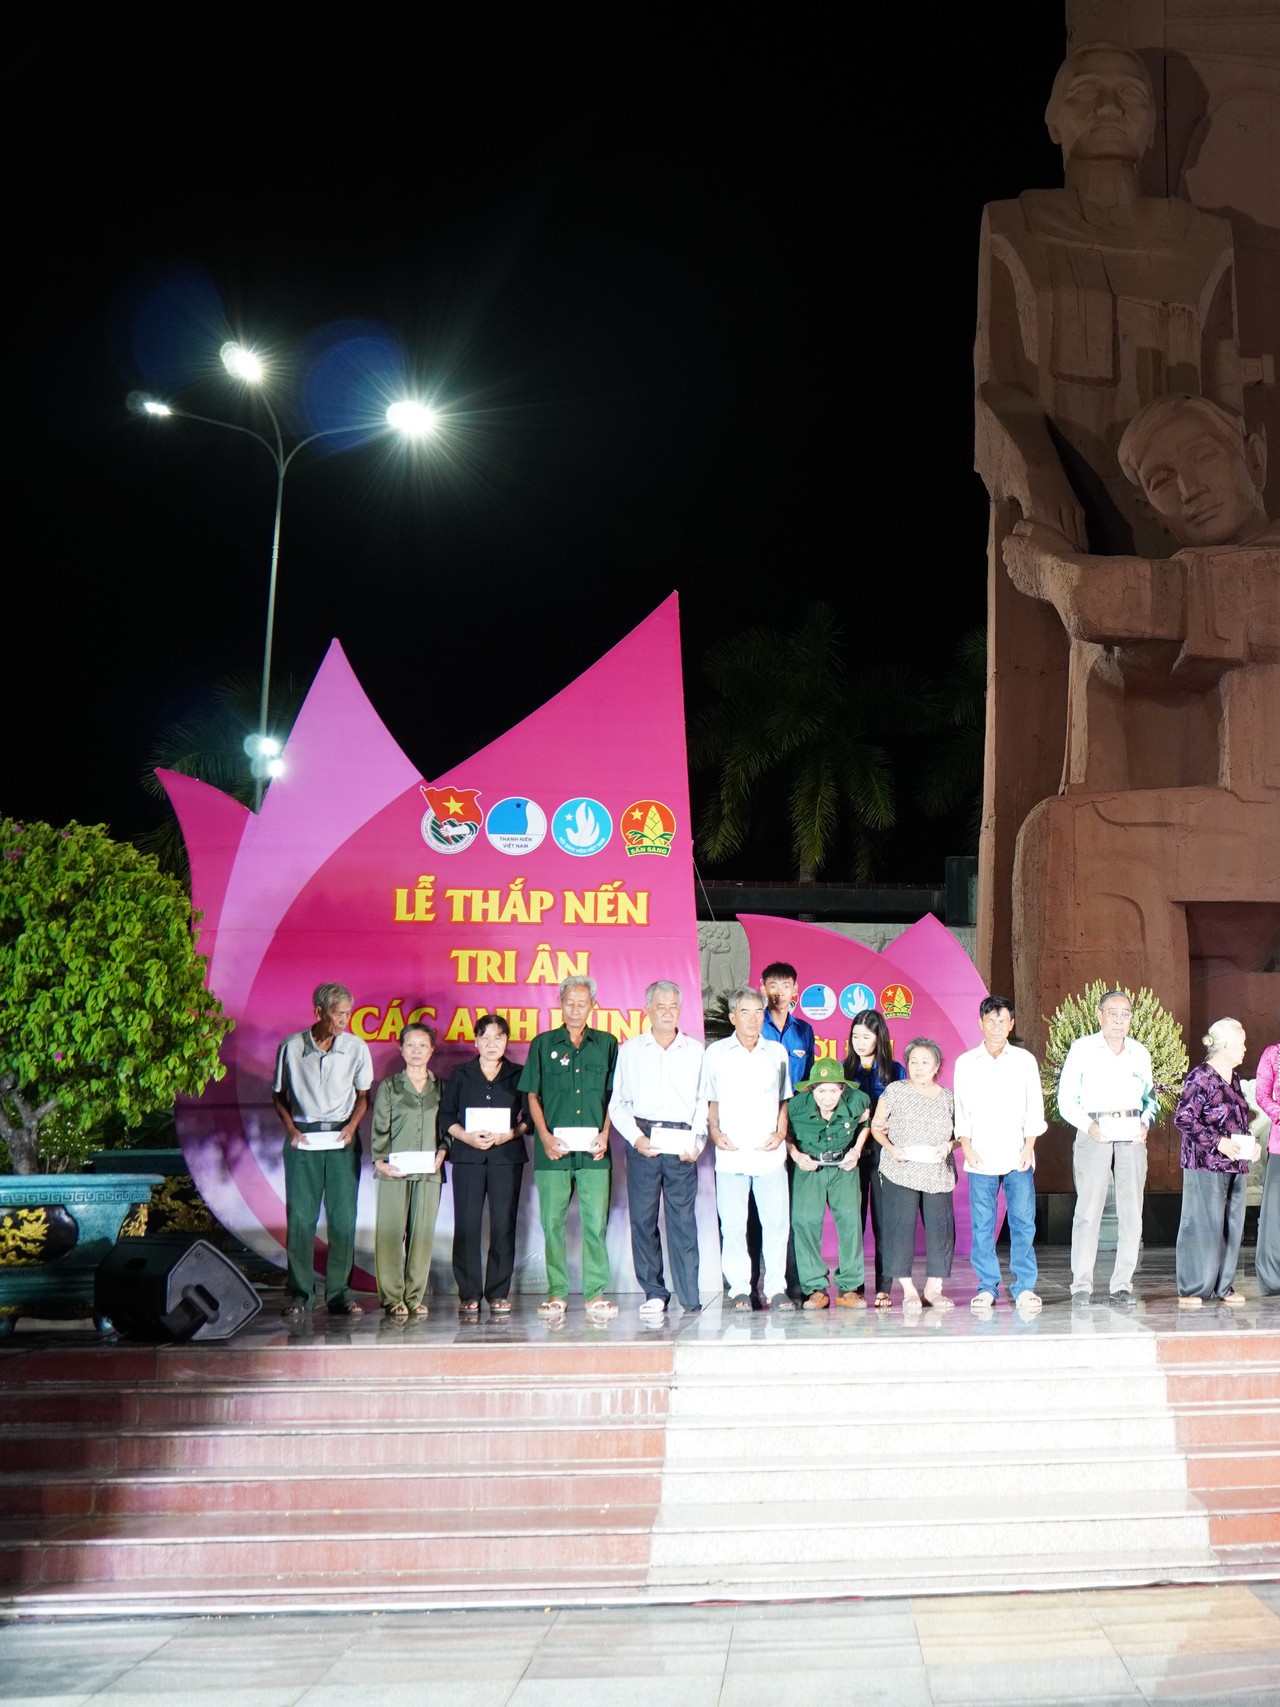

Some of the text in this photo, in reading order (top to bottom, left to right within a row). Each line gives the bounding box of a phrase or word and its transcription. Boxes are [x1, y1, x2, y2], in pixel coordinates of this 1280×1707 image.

[393, 875, 649, 925] LỄ THẮP NẾN
[450, 943, 591, 985] TRI ÂN
